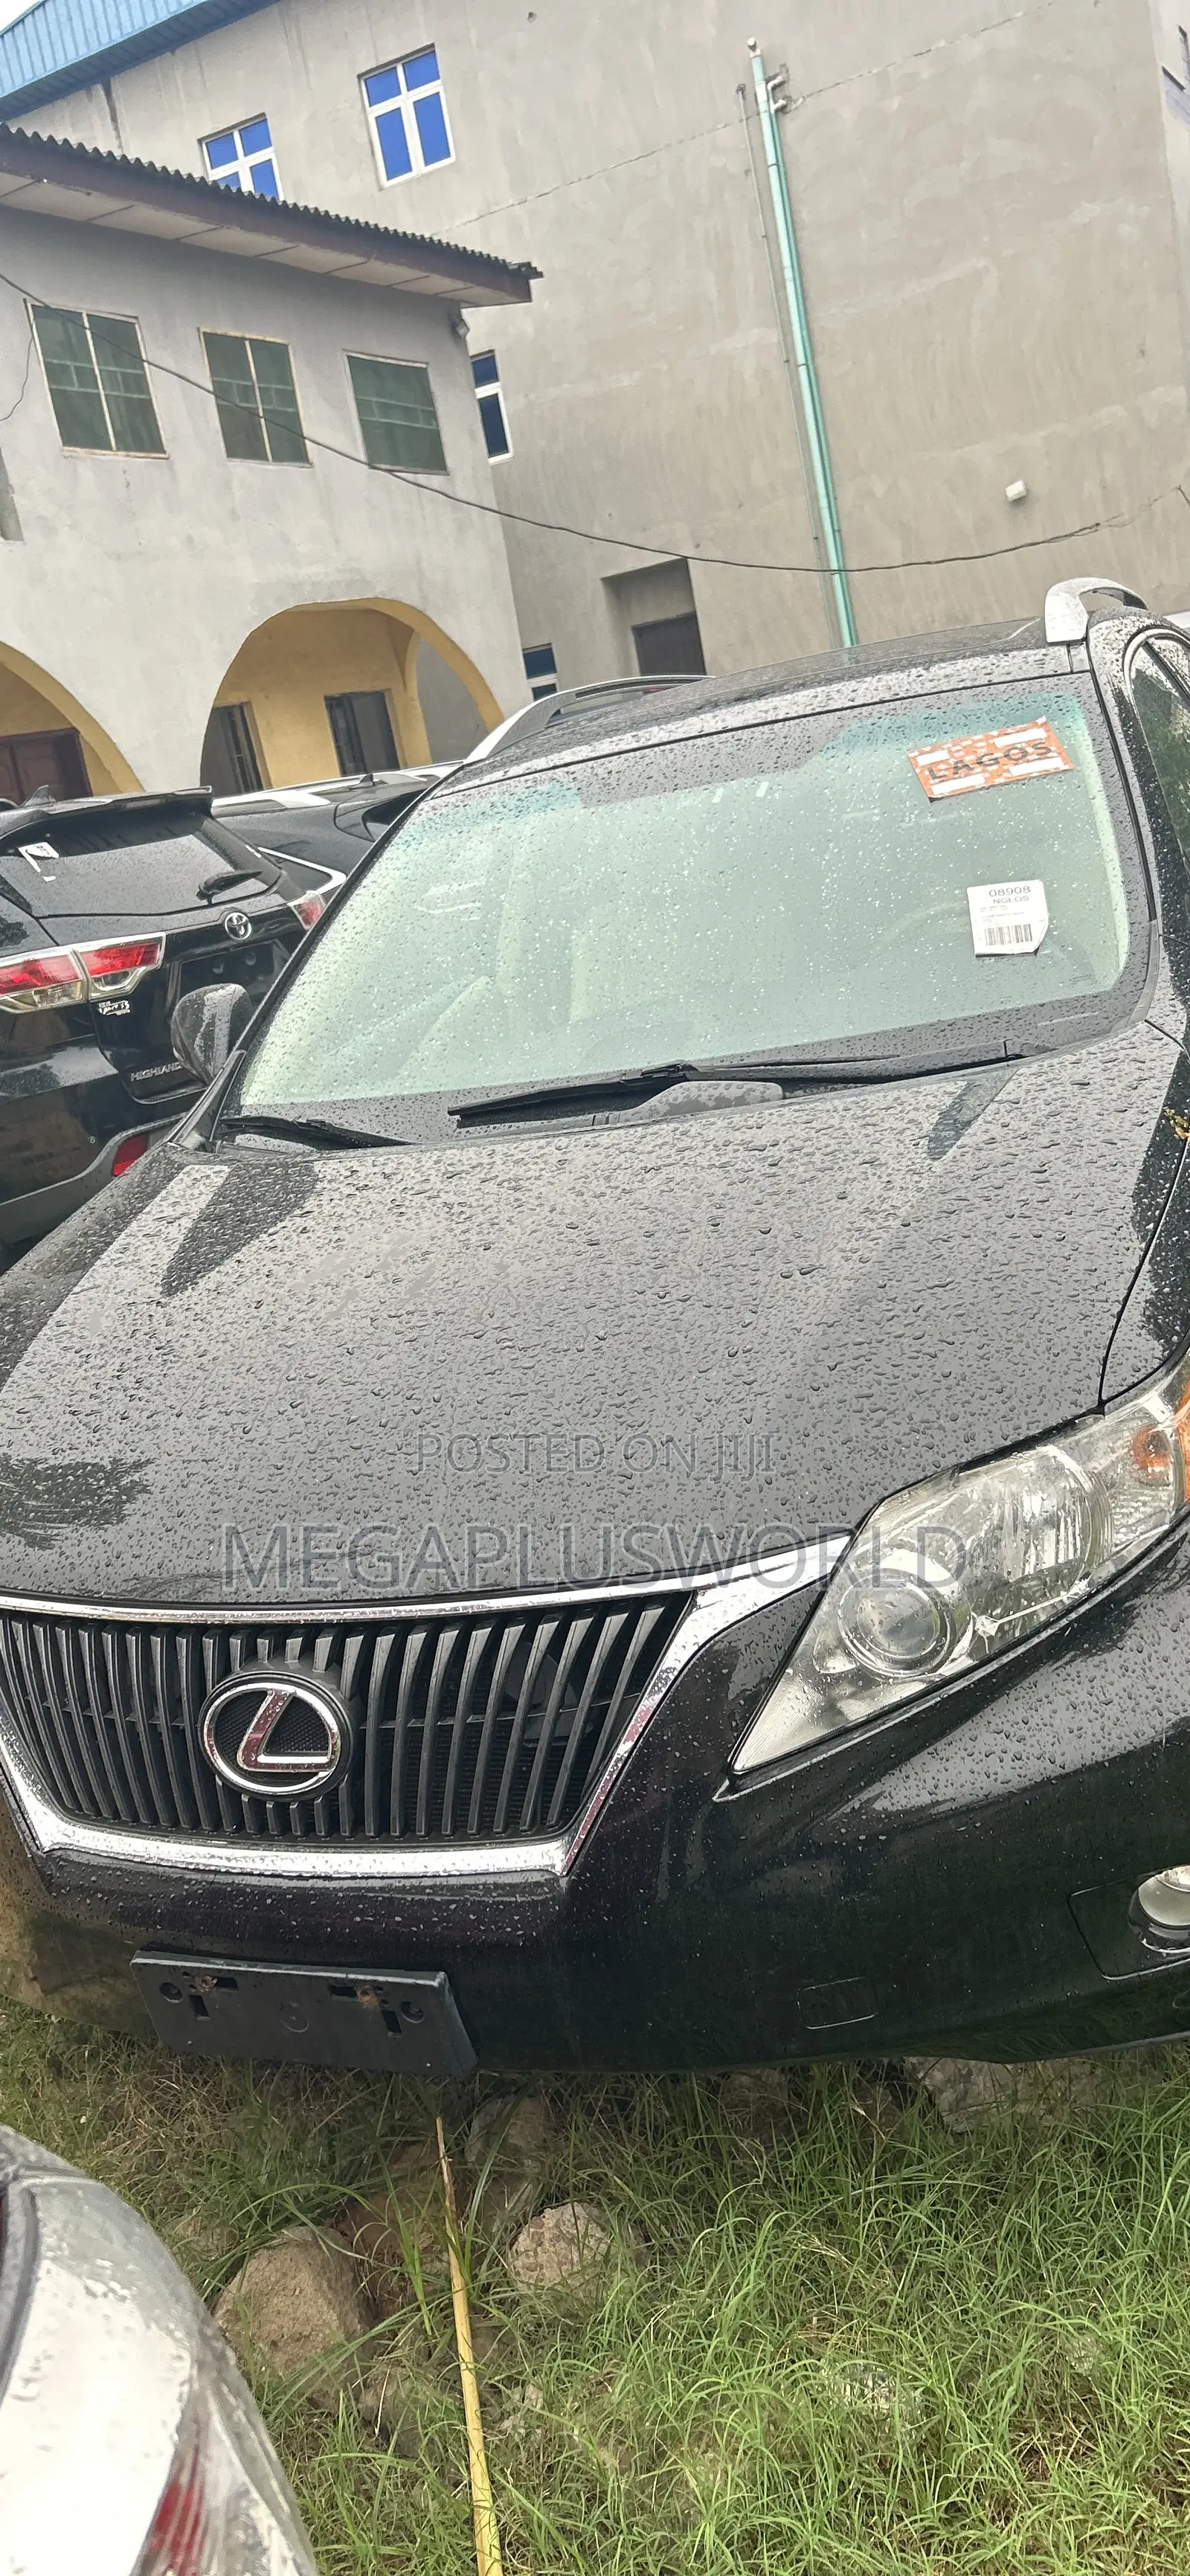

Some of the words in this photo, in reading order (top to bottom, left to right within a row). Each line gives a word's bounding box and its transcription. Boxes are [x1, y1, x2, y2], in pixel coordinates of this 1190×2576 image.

[928, 741, 1052, 782] LAGOS
[988, 885, 1031, 897] 08908
[130, 1061, 183, 1082] HIGHLAND
